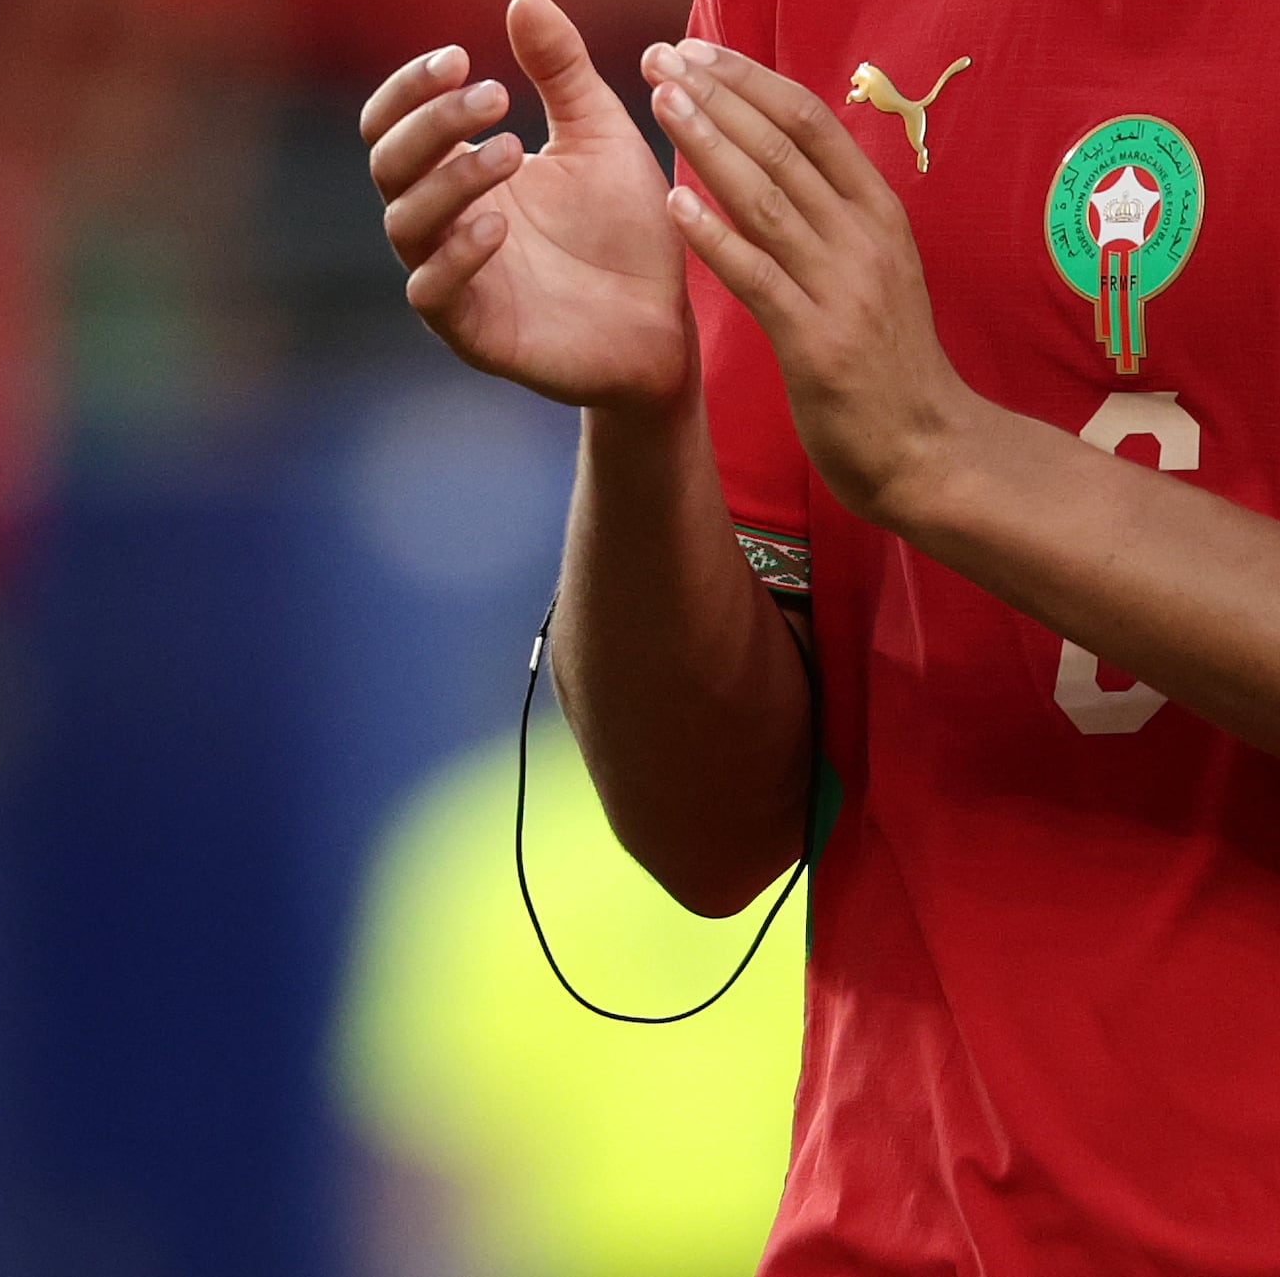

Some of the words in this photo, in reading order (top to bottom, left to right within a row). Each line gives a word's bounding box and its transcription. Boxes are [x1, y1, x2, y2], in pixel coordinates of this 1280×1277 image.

[1084, 155, 1117, 189] ROYALE
[1119, 152, 1169, 182] MAROCAINE
[1164, 183, 1173, 197] DE
[1145, 202, 1173, 255] FOOTBALL
[1100, 275, 1137, 291] FRMF
